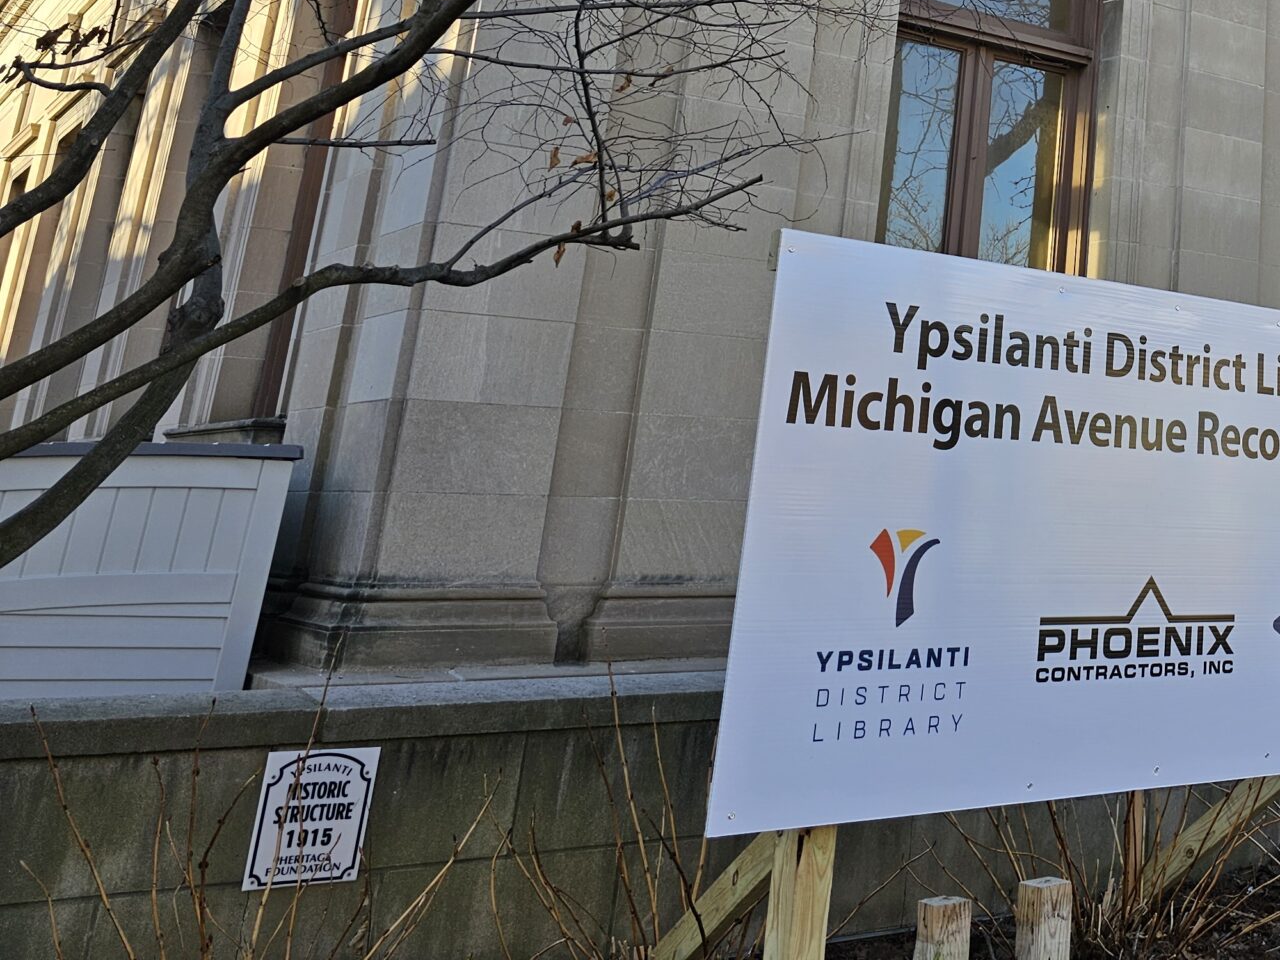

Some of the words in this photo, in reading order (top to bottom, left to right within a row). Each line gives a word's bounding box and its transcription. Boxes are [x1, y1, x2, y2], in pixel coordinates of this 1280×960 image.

[885, 300, 1092, 370] Ypsilanti
[1104, 331, 1247, 392] District
[785, 370, 1022, 451] Michigan
[1031, 395, 1188, 454] Avenue
[1036, 624, 1235, 662] PHOENIX
[816, 645, 971, 674] YPSILANTI
[1034, 660, 1196, 683] CONTRACTORS,
[1202, 659, 1234, 675] INC
[815, 681, 967, 707] DISTRICT
[811, 713, 964, 743] LIBRARY
[286, 779, 351, 801] HISTORIC
[272, 802, 355, 825] STRUCTURE
[285, 827, 334, 849] 1915
[264, 862, 342, 877] FOUNDATION
